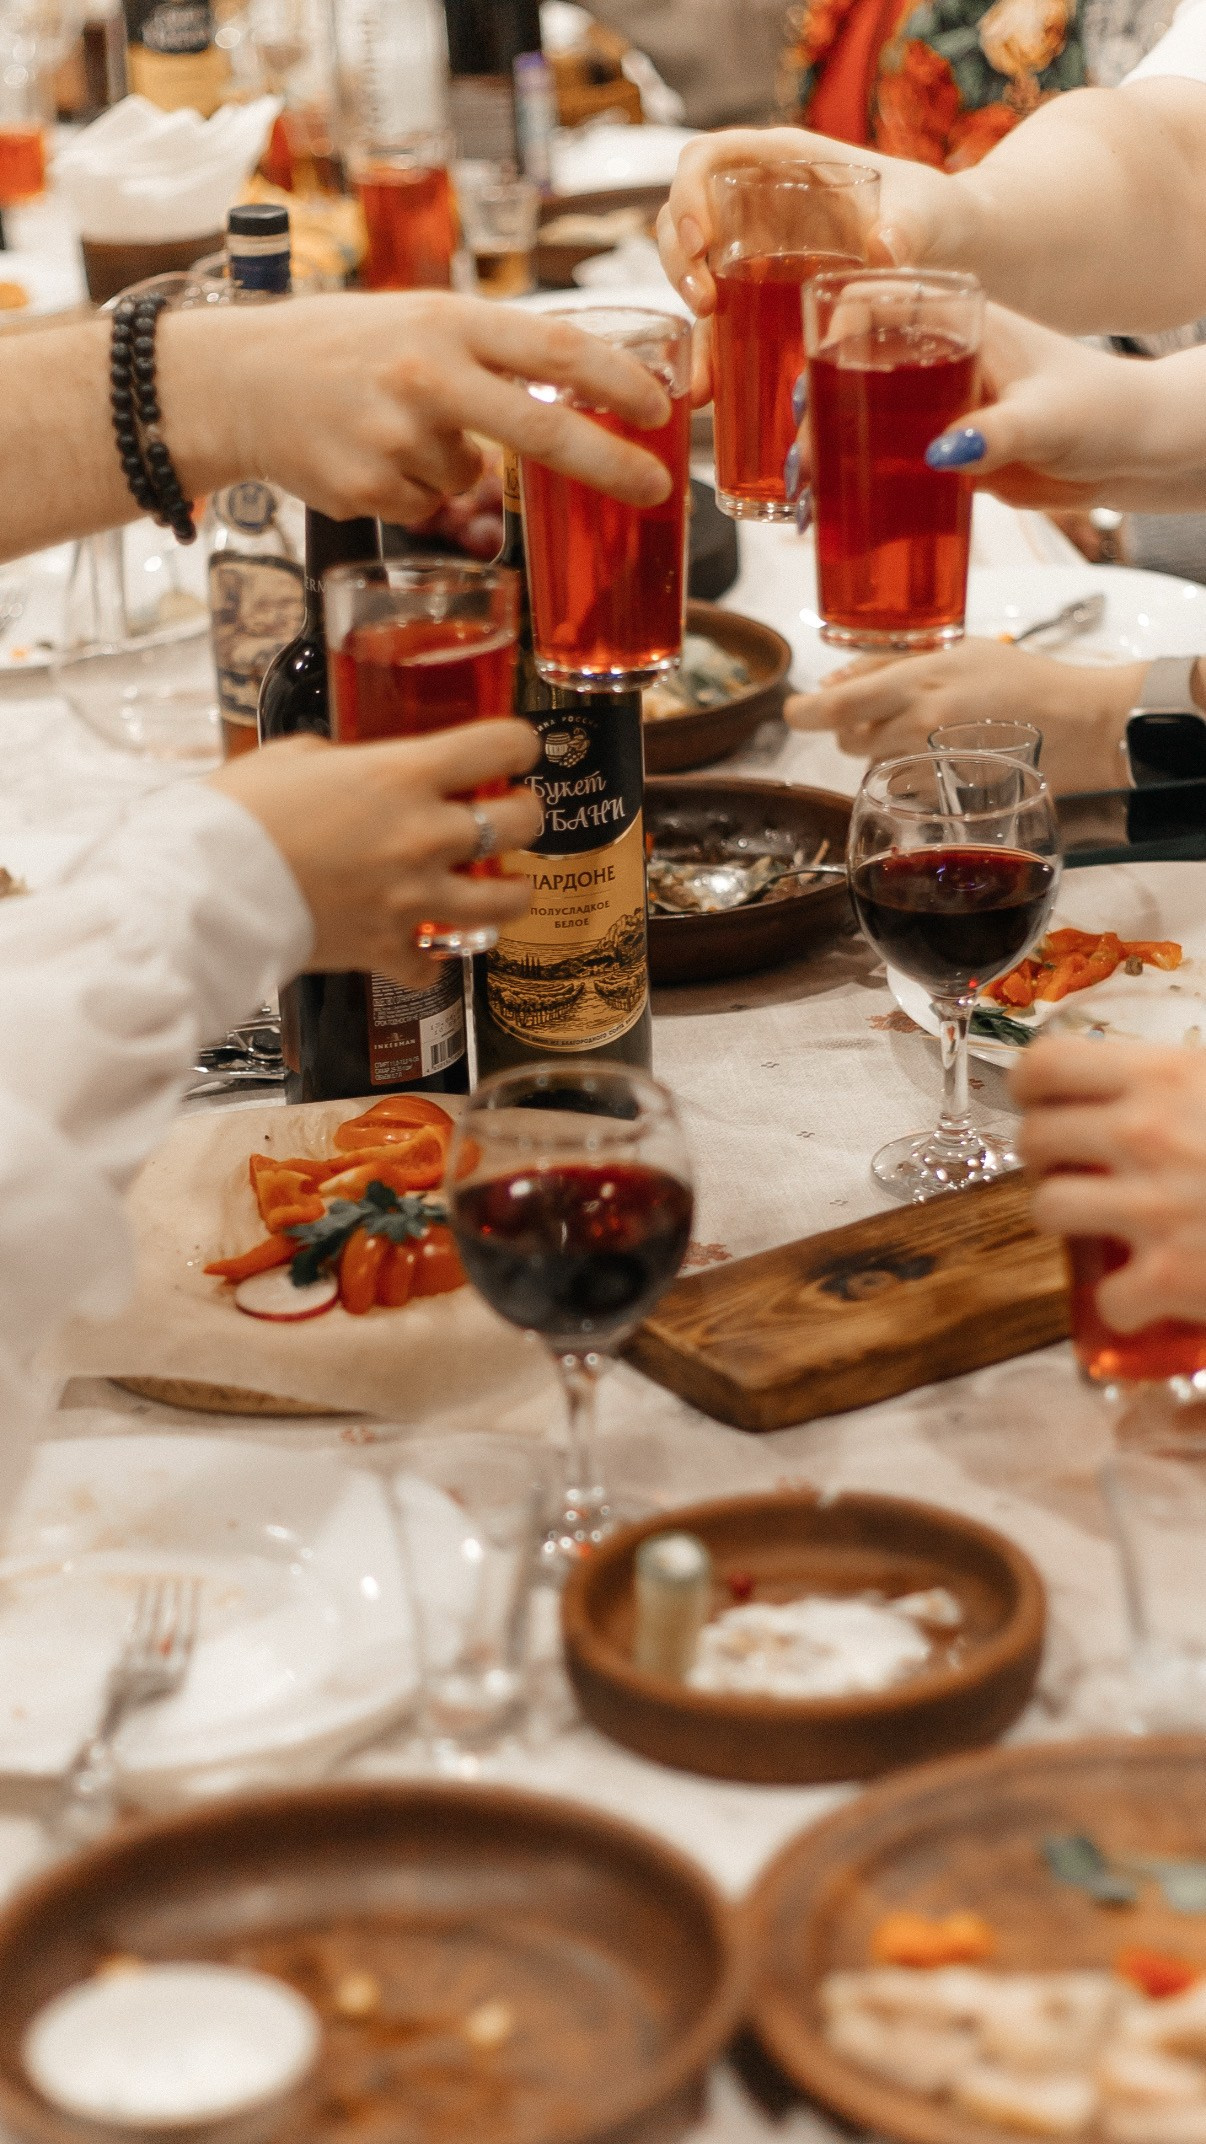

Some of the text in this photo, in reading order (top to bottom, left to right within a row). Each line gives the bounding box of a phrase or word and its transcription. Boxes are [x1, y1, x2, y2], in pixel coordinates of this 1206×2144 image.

[524, 770, 607, 805] Букет
[530, 900, 611, 916] ПОЛУСЛАДКОЕ
[554, 917, 590, 929] БЕЛОЕ
[374, 1039, 416, 1050] INKERMAN
